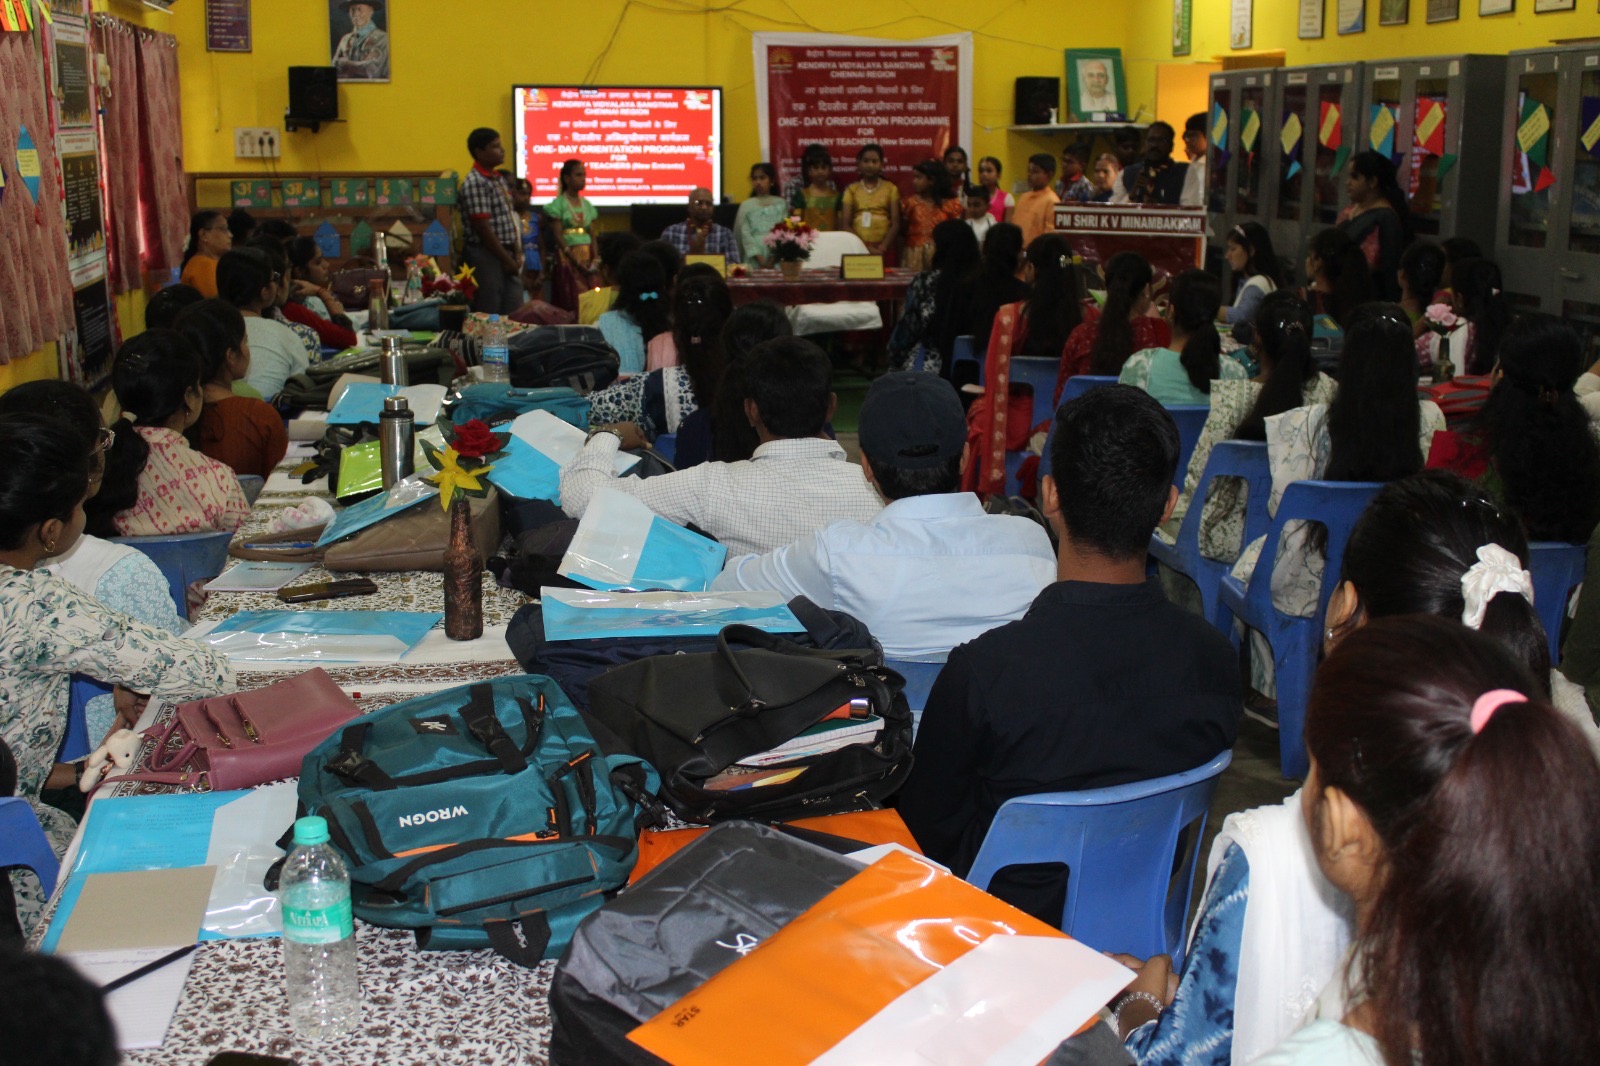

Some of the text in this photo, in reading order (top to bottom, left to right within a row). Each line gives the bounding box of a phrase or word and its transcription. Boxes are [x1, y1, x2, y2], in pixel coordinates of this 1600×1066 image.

[797, 61, 837, 70] KENDRIYA
[838, 61, 882, 70] VIDYALAYA
[883, 61, 925, 70] SANGTHAN
[830, 70, 896, 79] CHENNAI REGION
[619, 108, 650, 116] REGION
[777, 116, 950, 127] ONE- DAY ORIENTATION PROGRAMME
[857, 128, 874, 136] FOR
[798, 138, 932, 147] PRIMARY TEACHERS (New Entrants)
[533, 145, 704, 155] ONE- DAY ORIENTATION PROGRAMME
[610, 154, 627, 162] FOR
[590, 162, 631, 170] TEACHERS
[1056, 213, 1202, 231] PM SHRI K V MINAMBAKKAM
[398, 804, 469, 828] WROGN
[671, 1006, 700, 1027] STAR
